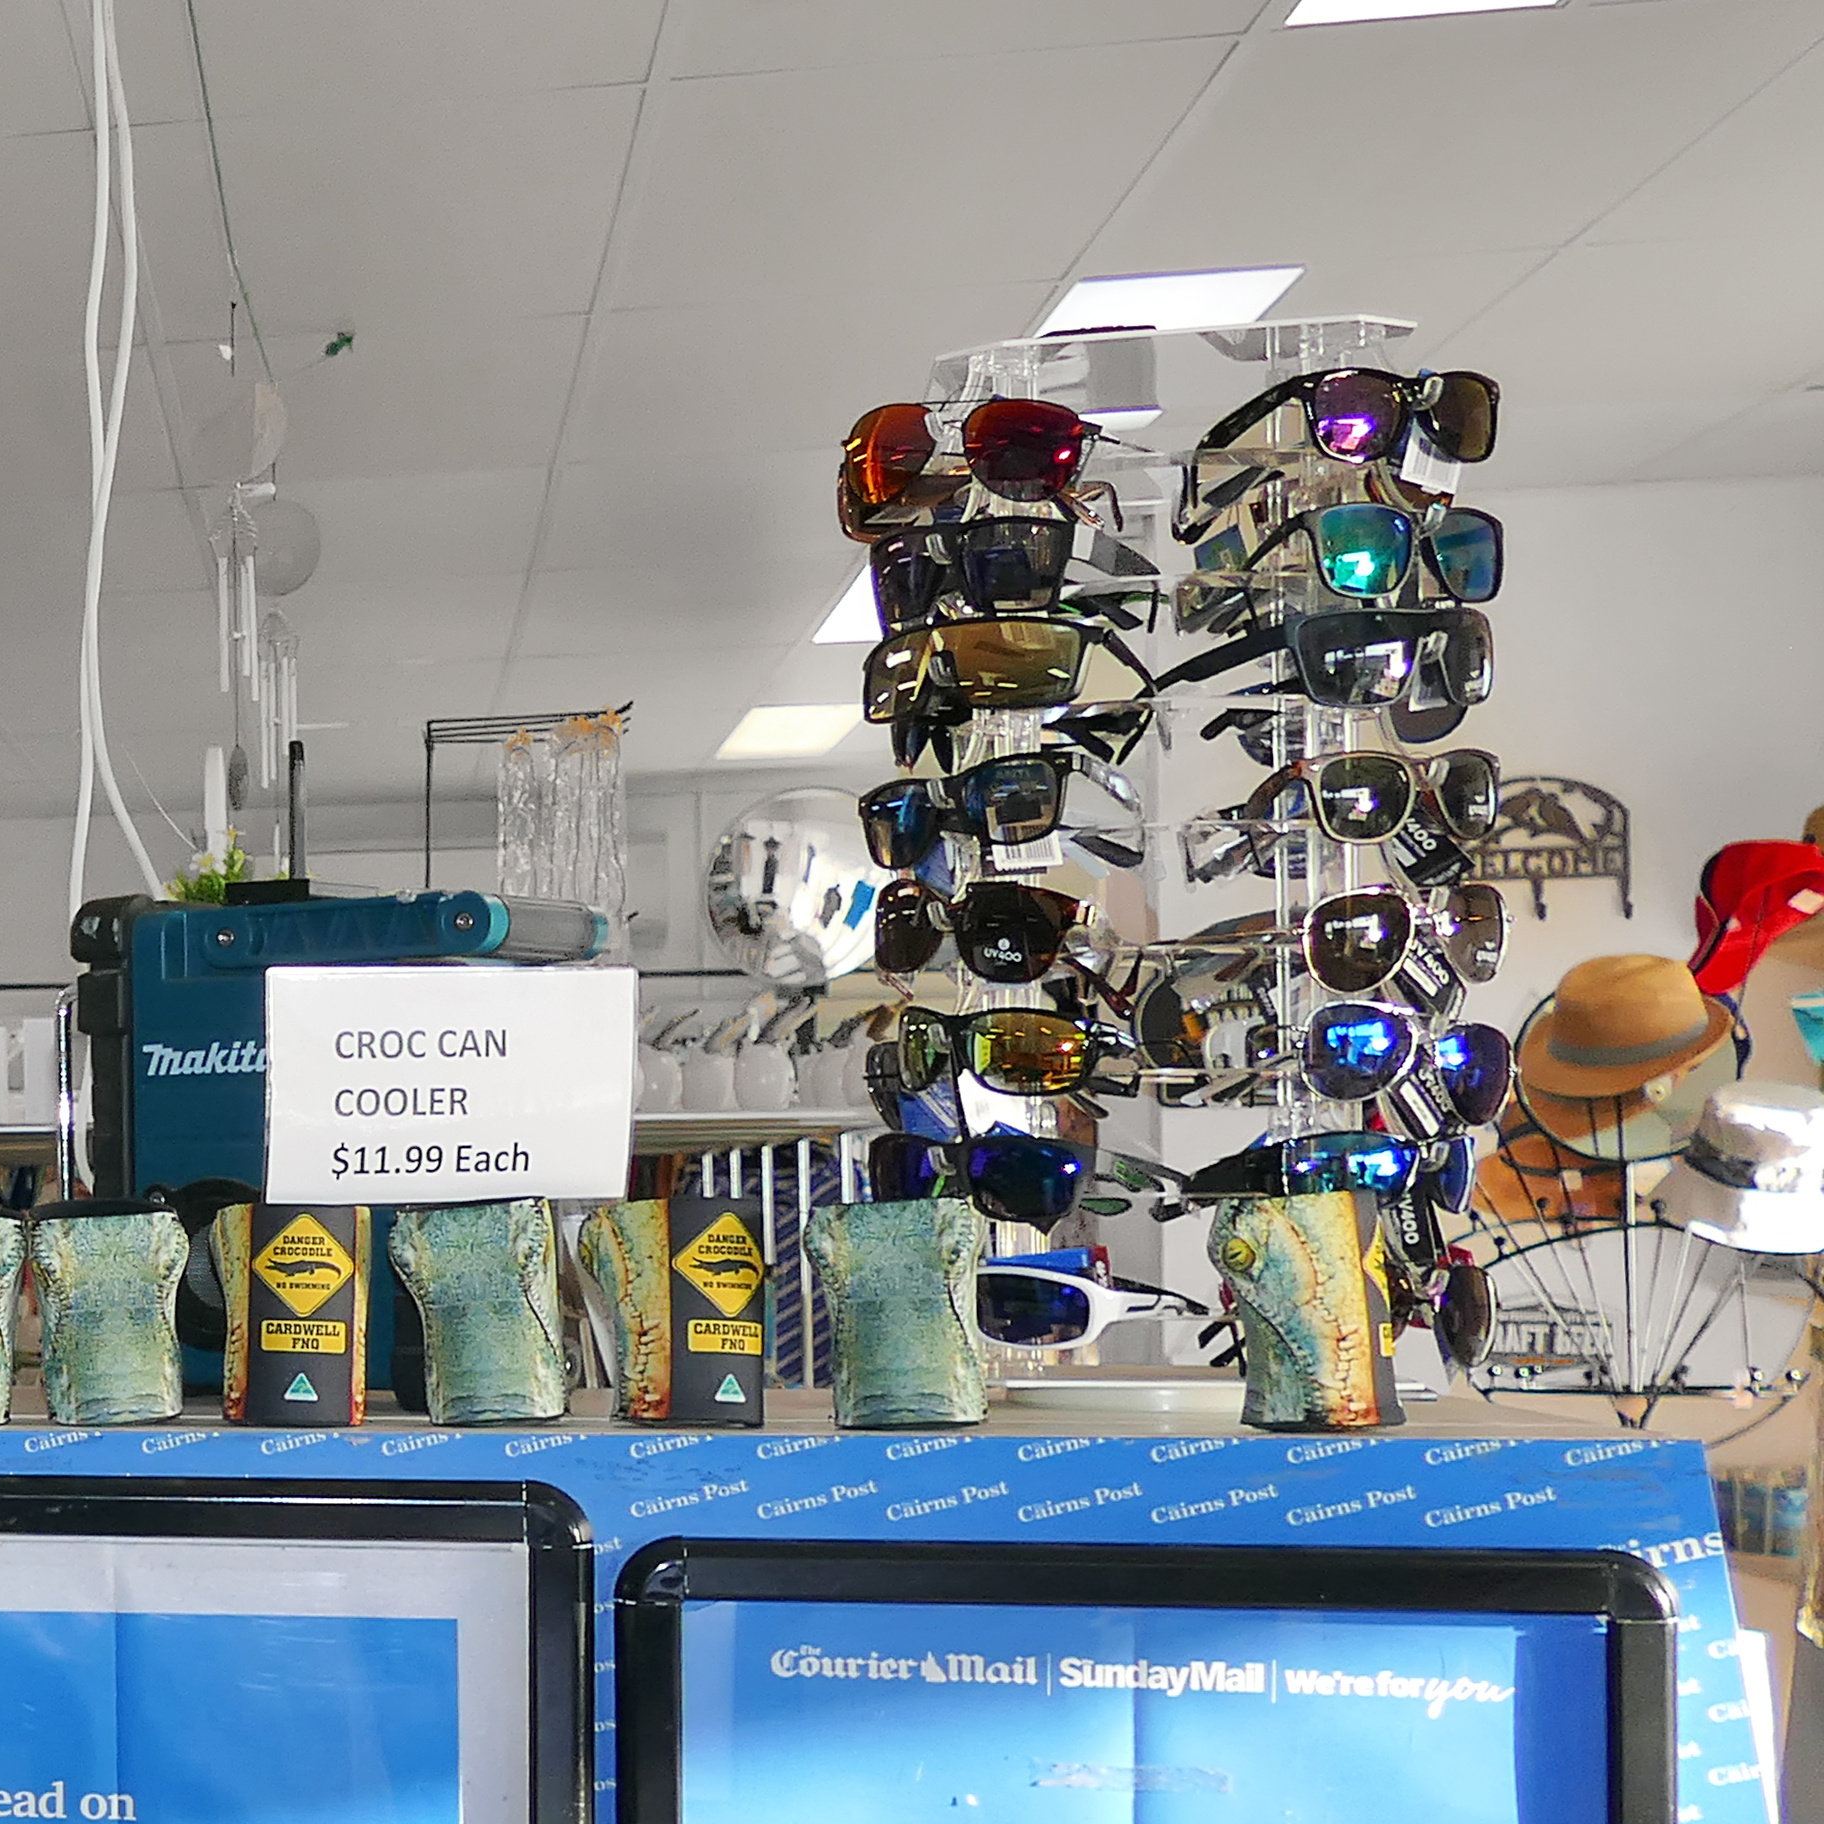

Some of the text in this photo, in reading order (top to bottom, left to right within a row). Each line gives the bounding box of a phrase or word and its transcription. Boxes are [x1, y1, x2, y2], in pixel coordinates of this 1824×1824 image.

[334, 1027, 508, 1060] CROC CAN
[334, 1086, 470, 1118] COOLER
[330, 1142, 531, 1181] $11.99 Each
[756, 1479, 880, 1522] Cairns Post
[770, 1645, 919, 1680] Courier
[946, 1651, 1038, 1689] Mail
[1424, 1672, 1515, 1719] you
[80, 1789, 137, 1823] on
